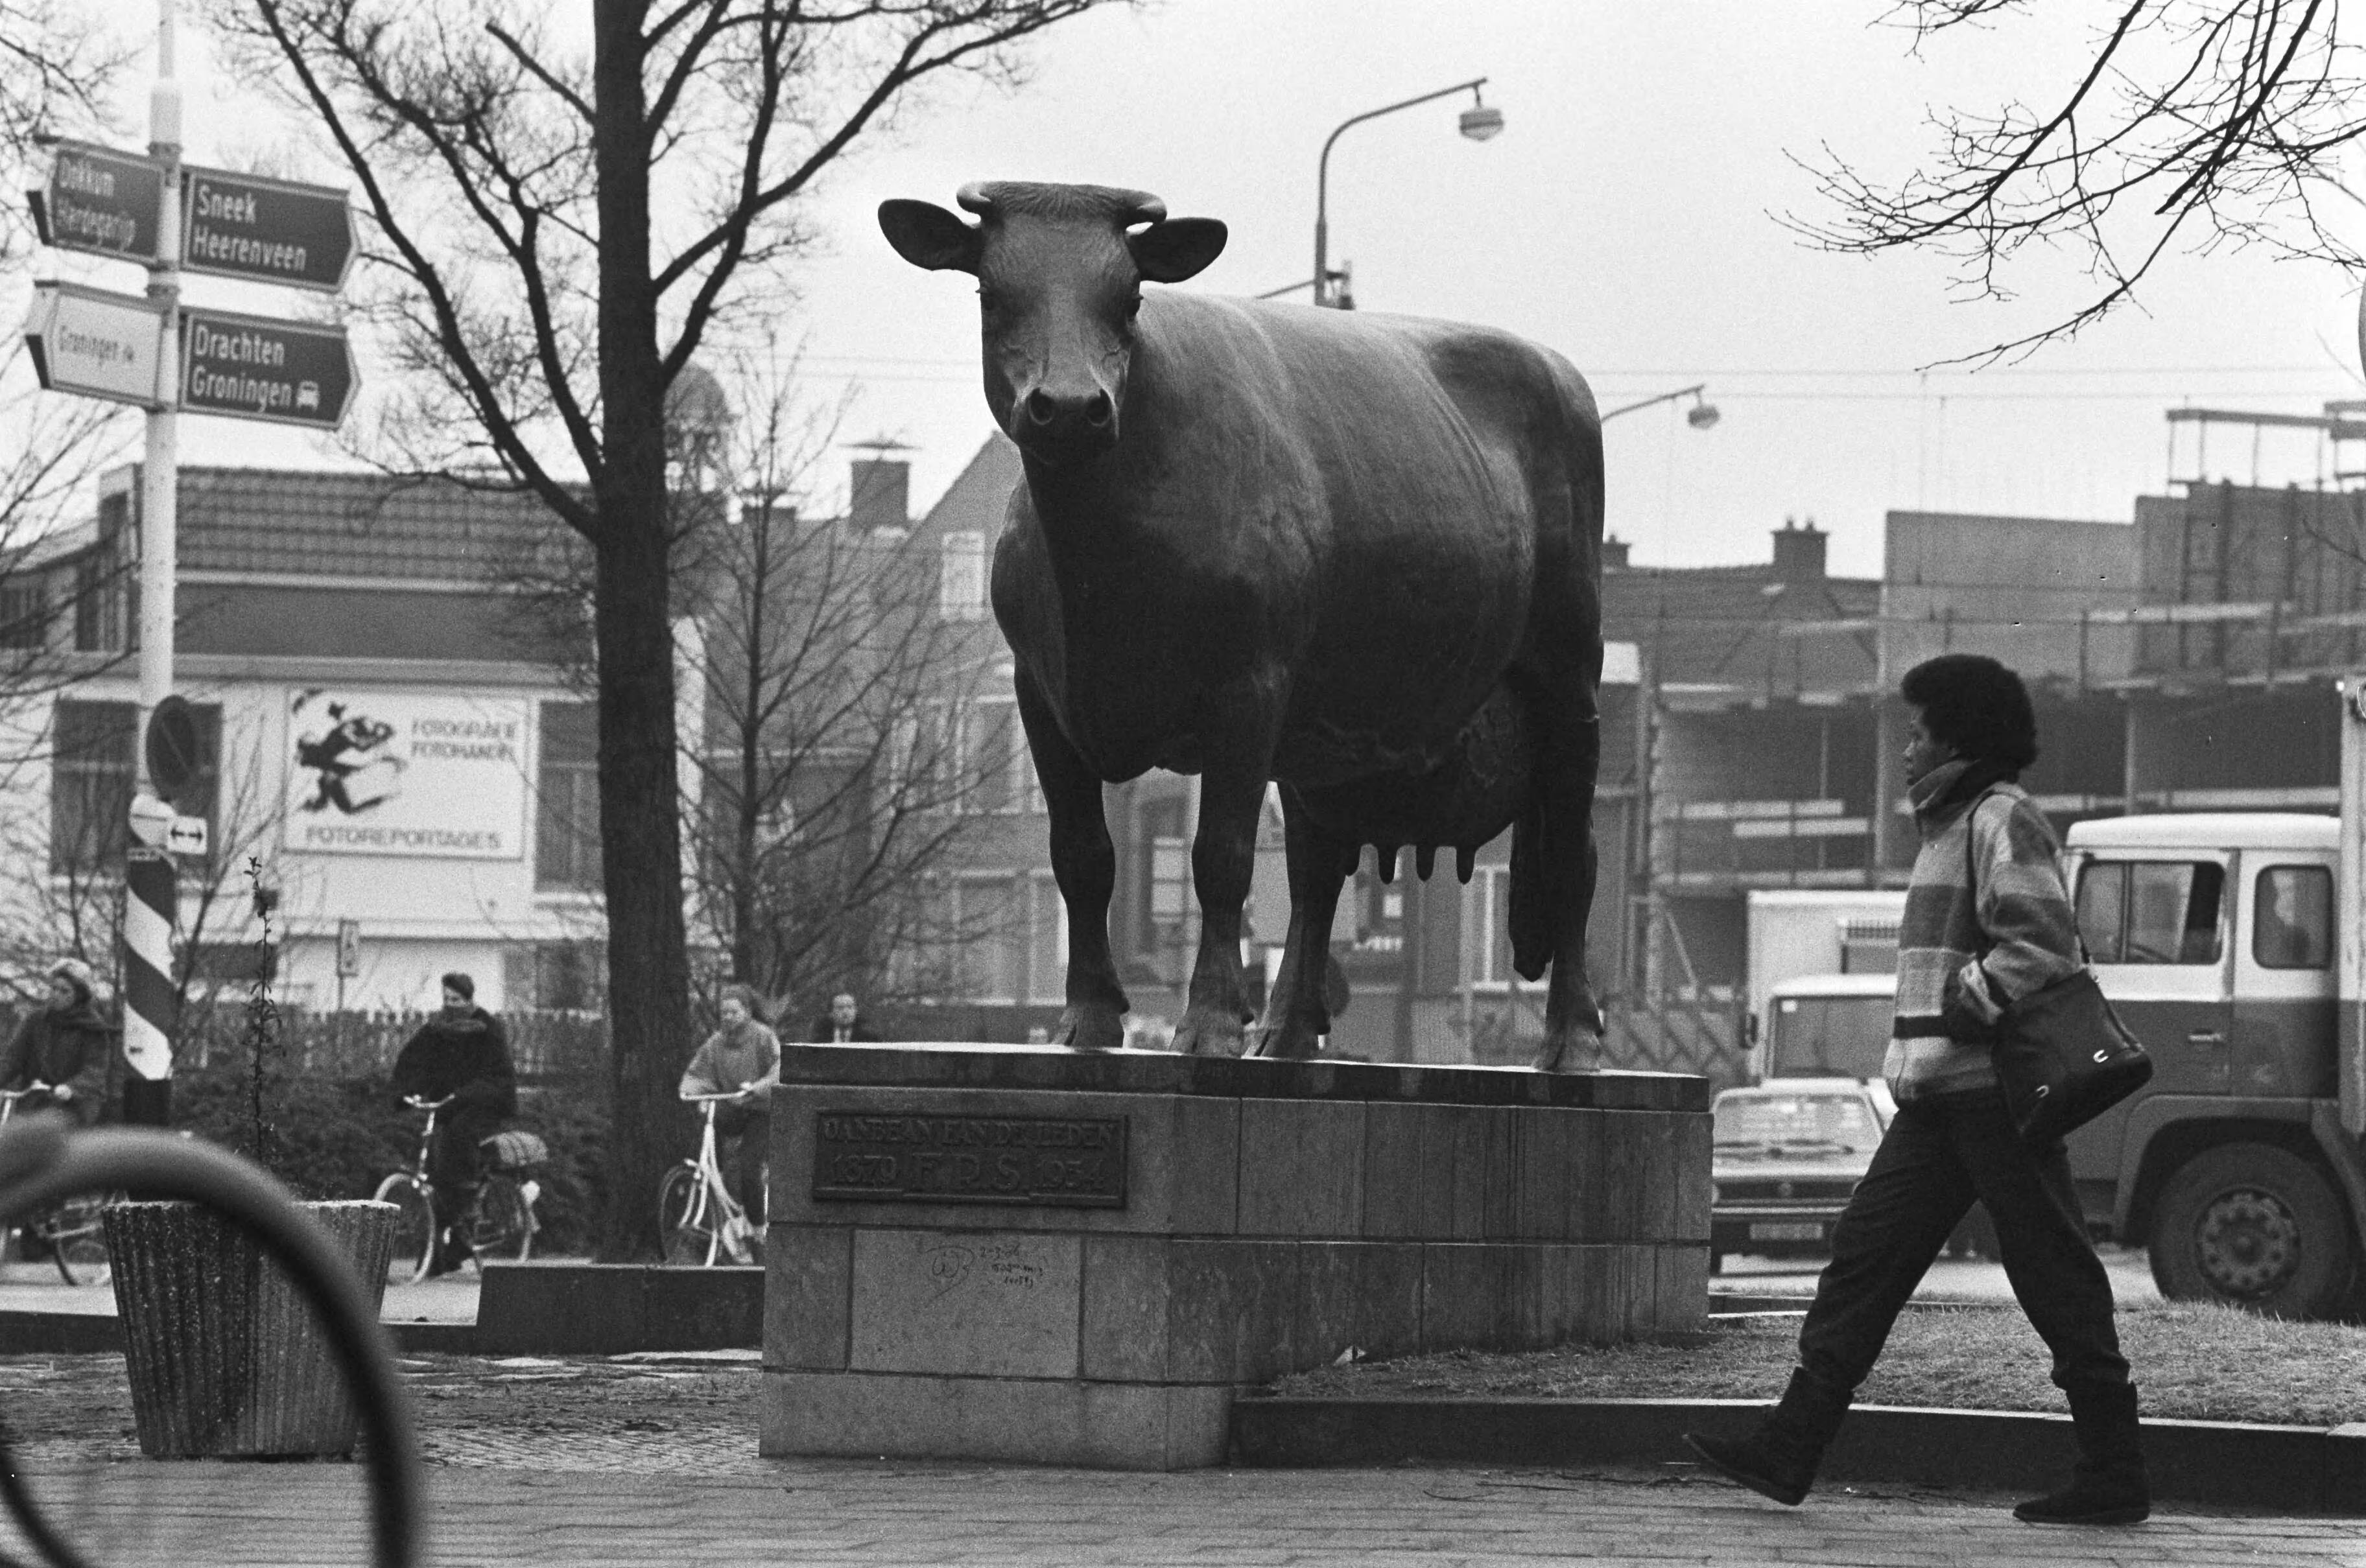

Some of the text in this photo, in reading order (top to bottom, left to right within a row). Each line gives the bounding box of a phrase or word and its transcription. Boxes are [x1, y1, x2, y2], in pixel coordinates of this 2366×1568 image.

[197, 184, 257, 224] Sneek
[195, 224, 307, 272] Heerenveen
[195, 326, 285, 366] Drachten
[194, 367, 292, 413] Groningen
[306, 825, 502, 849] FOTOREPORTAGES
[1035, 1122, 1115, 1149] LEDEN
